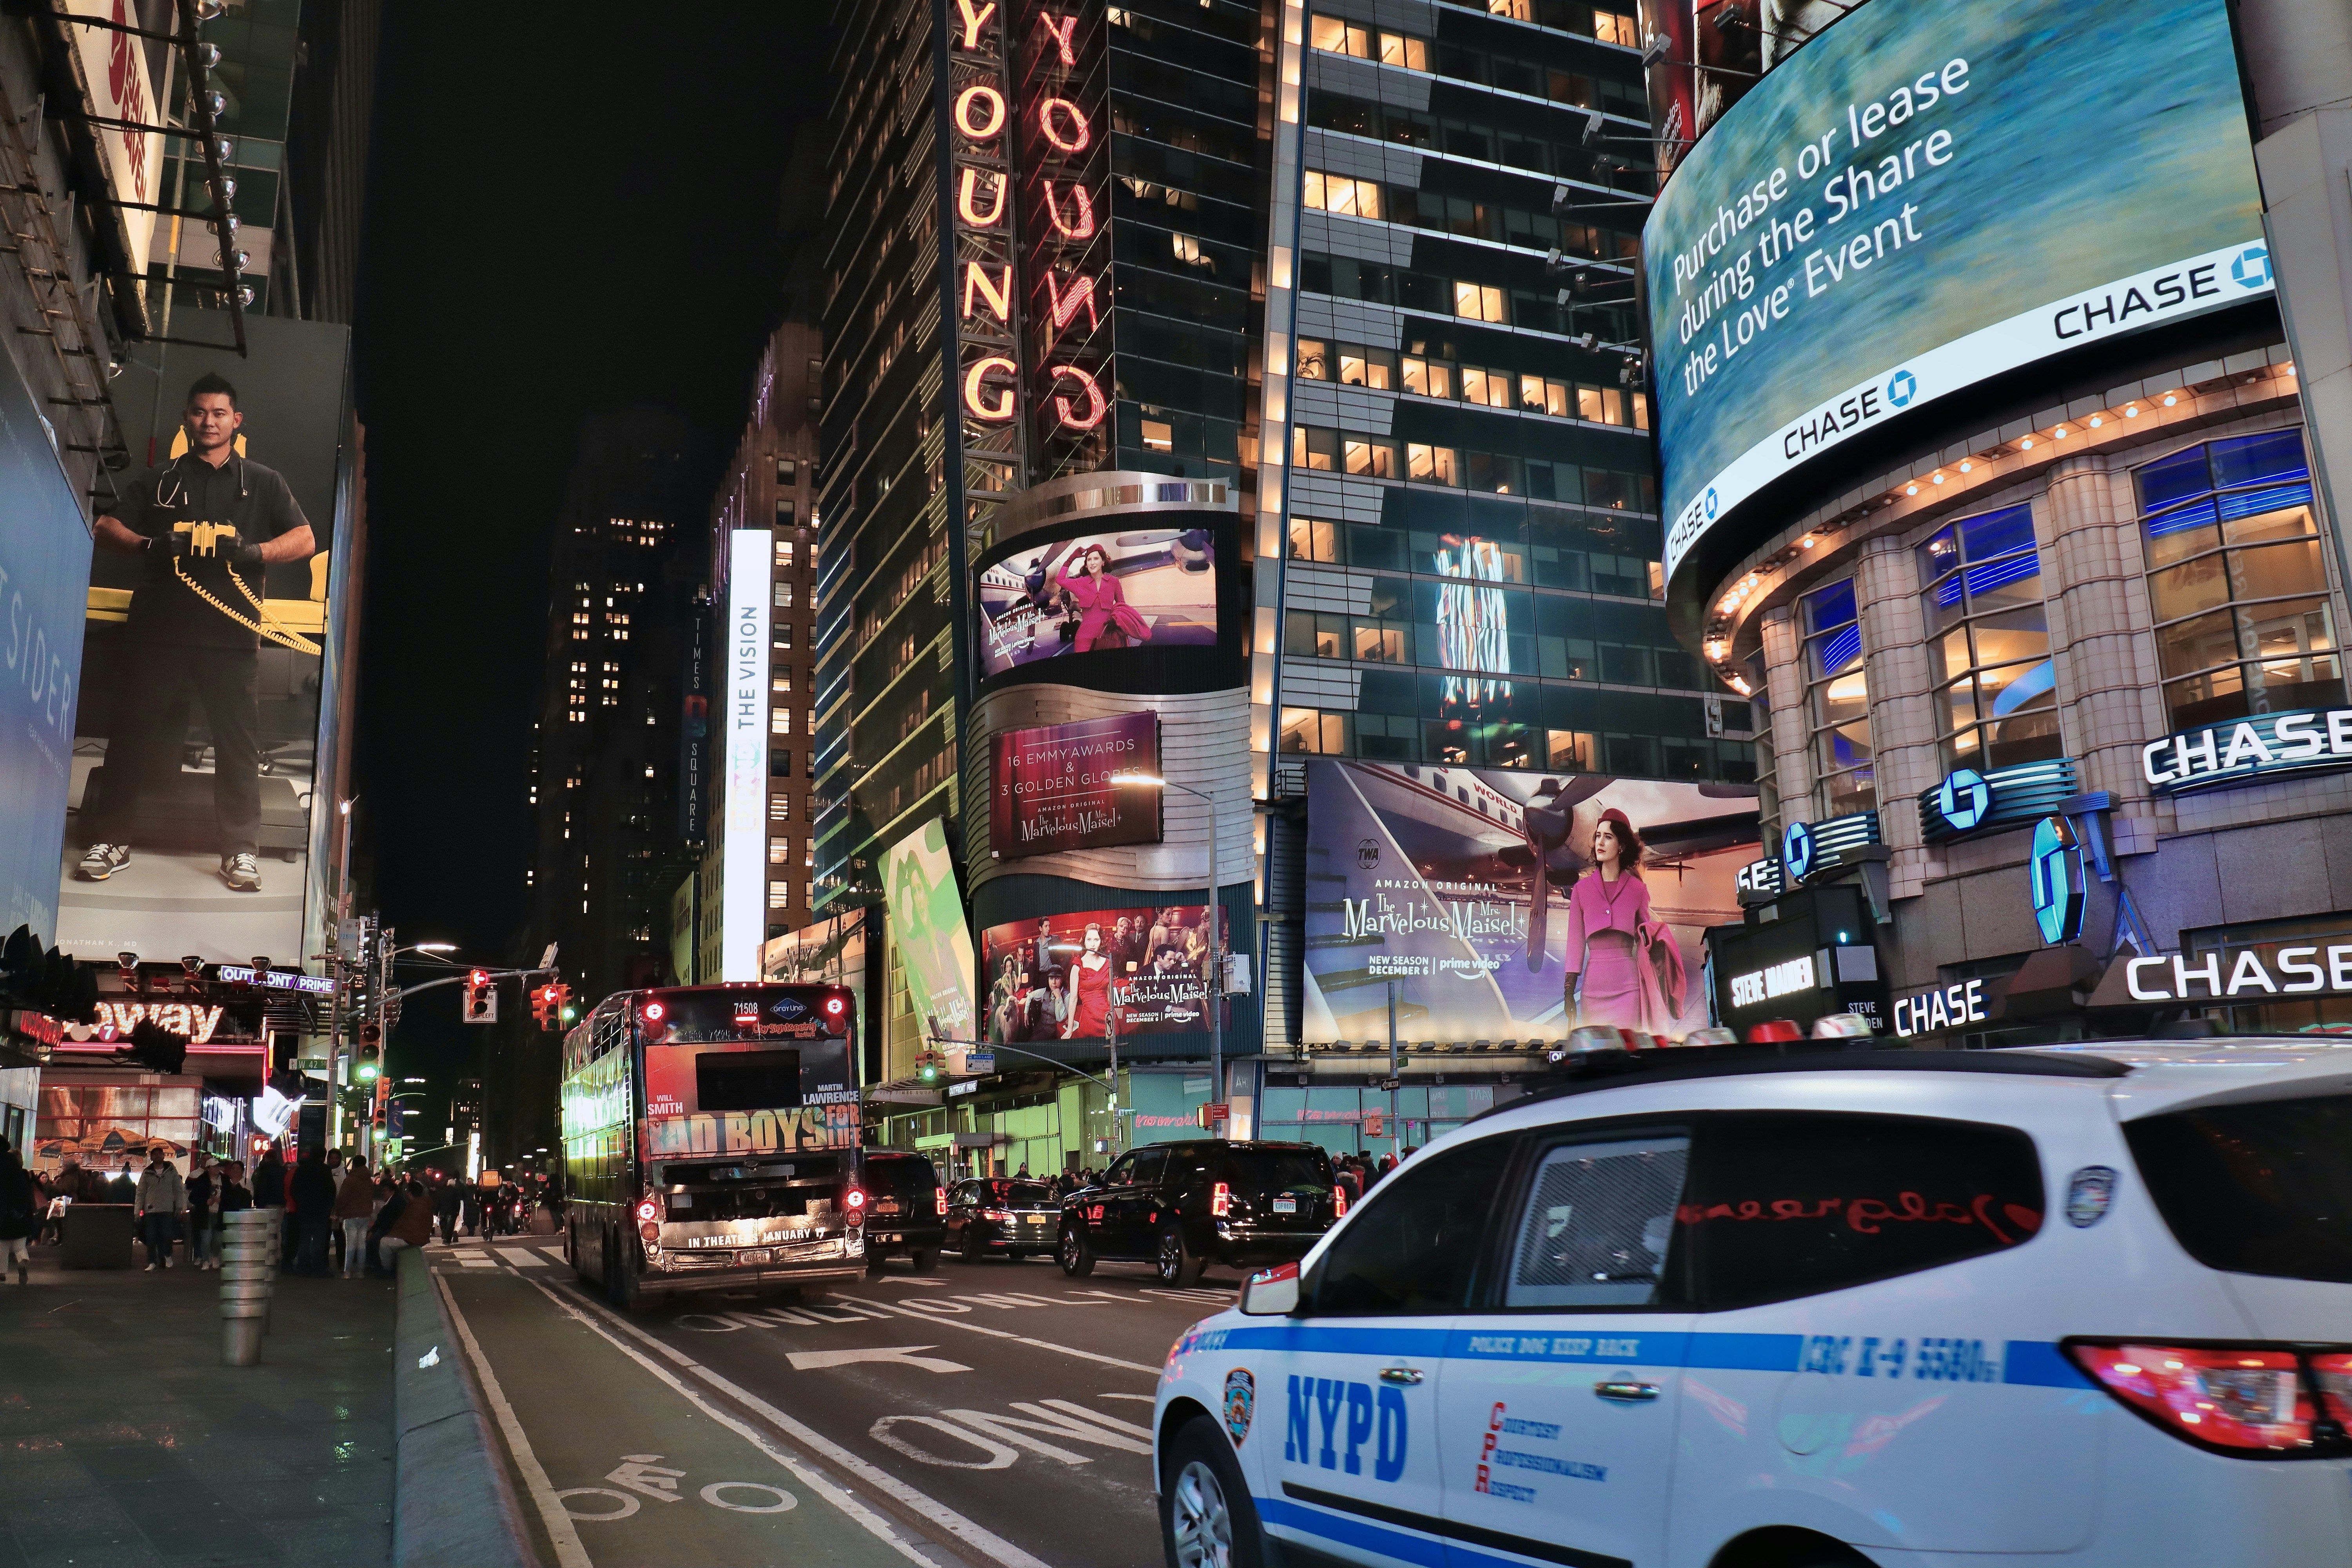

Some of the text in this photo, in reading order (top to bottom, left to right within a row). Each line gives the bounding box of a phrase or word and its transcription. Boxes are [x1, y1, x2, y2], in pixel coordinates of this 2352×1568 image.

[1673, 56, 1970, 296] Purchase or lease
[958, 0, 1018, 419] YOUNG
[1679, 127, 1954, 346] during the Share
[1684, 345, 1719, 397] the
[1807, 202, 1923, 298] Event
[2054, 261, 2221, 341] CHASE
[1784, 386, 1881, 461] CHASE
[1671, 501, 1704, 563] CHASE
[996, 602, 1034, 622] AMAZON ORIGINAL
[989, 608, 1042, 646] Marvelous Maisel
[739, 606, 757, 681] VISION
[738, 689, 756, 730] THE
[689, 618, 702, 832] TIMES SQUARE
[1007, 755, 1021, 768] 16
[1071, 738, 1135, 759] AWARDS
[2142, 711, 2352, 785] CHASE
[1065, 761, 1074, 773] &
[1001, 784, 1009, 796] 3
[1014, 775, 1074, 794] GOLDEN
[1037, 799, 1105, 813] AMAZON ORIGINAL
[1473, 782, 1517, 814] WORLD
[1021, 807, 1117, 842] Marvelous Maisel
[1038, 815, 1049, 826] The
[1357, 848, 1379, 860] TWA
[1375, 879, 1497, 891] AMAZON ORIGINAL
[1376, 893, 1396, 913] The
[1342, 898, 1515, 941] Marvelous Maisel
[1369, 955, 1429, 965] NEW SEASON
[1369, 965, 1429, 975] DECEMBER 6
[1439, 958, 1500, 971] prime video
[2127, 944, 2352, 1001] CHASE
[299, 978, 333, 992] PRIME
[930, 985, 958, 1001] AMAZON ORIGINAL
[1113, 982, 1208, 1007] Marvelous Maisel
[1129, 983, 1140, 993] The
[1731, 970, 1766, 1008] STEVE
[734, 1002, 758, 1014] 71508
[1848, 1002, 1876, 1014] STEVE
[1894, 979, 1986, 1039] CHASE
[103, 1025, 114, 1040] 7
[769, 1022, 817, 1034] Sightseeing
[299, 1060, 318, 1069] W 42
[657, 1094, 673, 1102] WILL
[803, 1090, 860, 1105] LAWRENCE
[817, 1083, 843, 1093] MARTIN
[949, 1082, 977, 1096] OUTFRONT PRIME
[648, 1101, 684, 1115] SMITH
[826, 1104, 860, 1127] FOR
[724, 1106, 826, 1156] BOYS
[827, 1127, 862, 1149] LIFE
[688, 1237, 700, 1248] IN
[762, 1228, 811, 1242] JANUARY
[815, 1227, 826, 1240] 17
[897, 1287, 1153, 1313] ONLY
[671, 1302, 896, 1333] ONLY
[1285, 1374, 1408, 1483] NYPD
